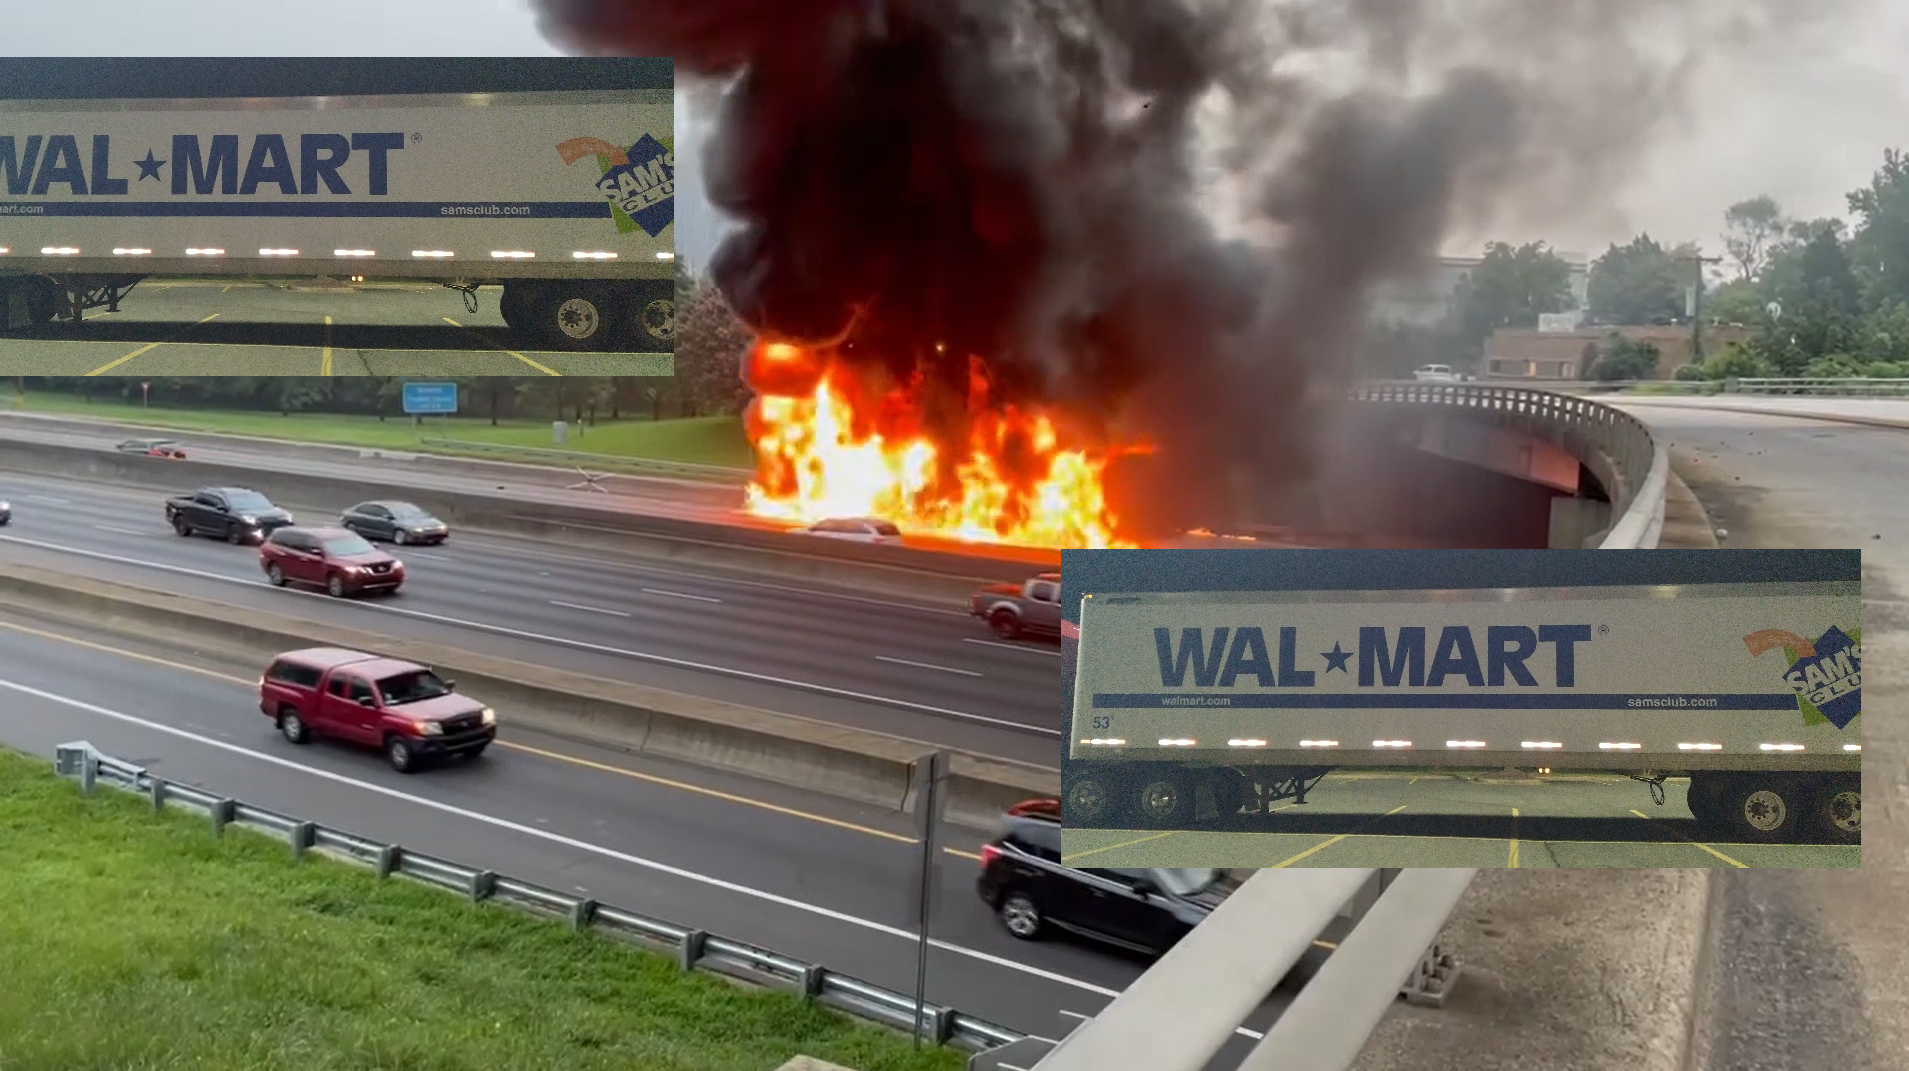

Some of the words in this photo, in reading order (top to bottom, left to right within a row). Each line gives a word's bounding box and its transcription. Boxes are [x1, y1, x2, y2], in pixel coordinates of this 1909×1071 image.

[0, 204, 44, 214] art.com
[441, 204, 531, 215] samsclub.com
[1162, 696, 1231, 706] walmart.com
[1627, 697, 1718, 707] samsclub.com
